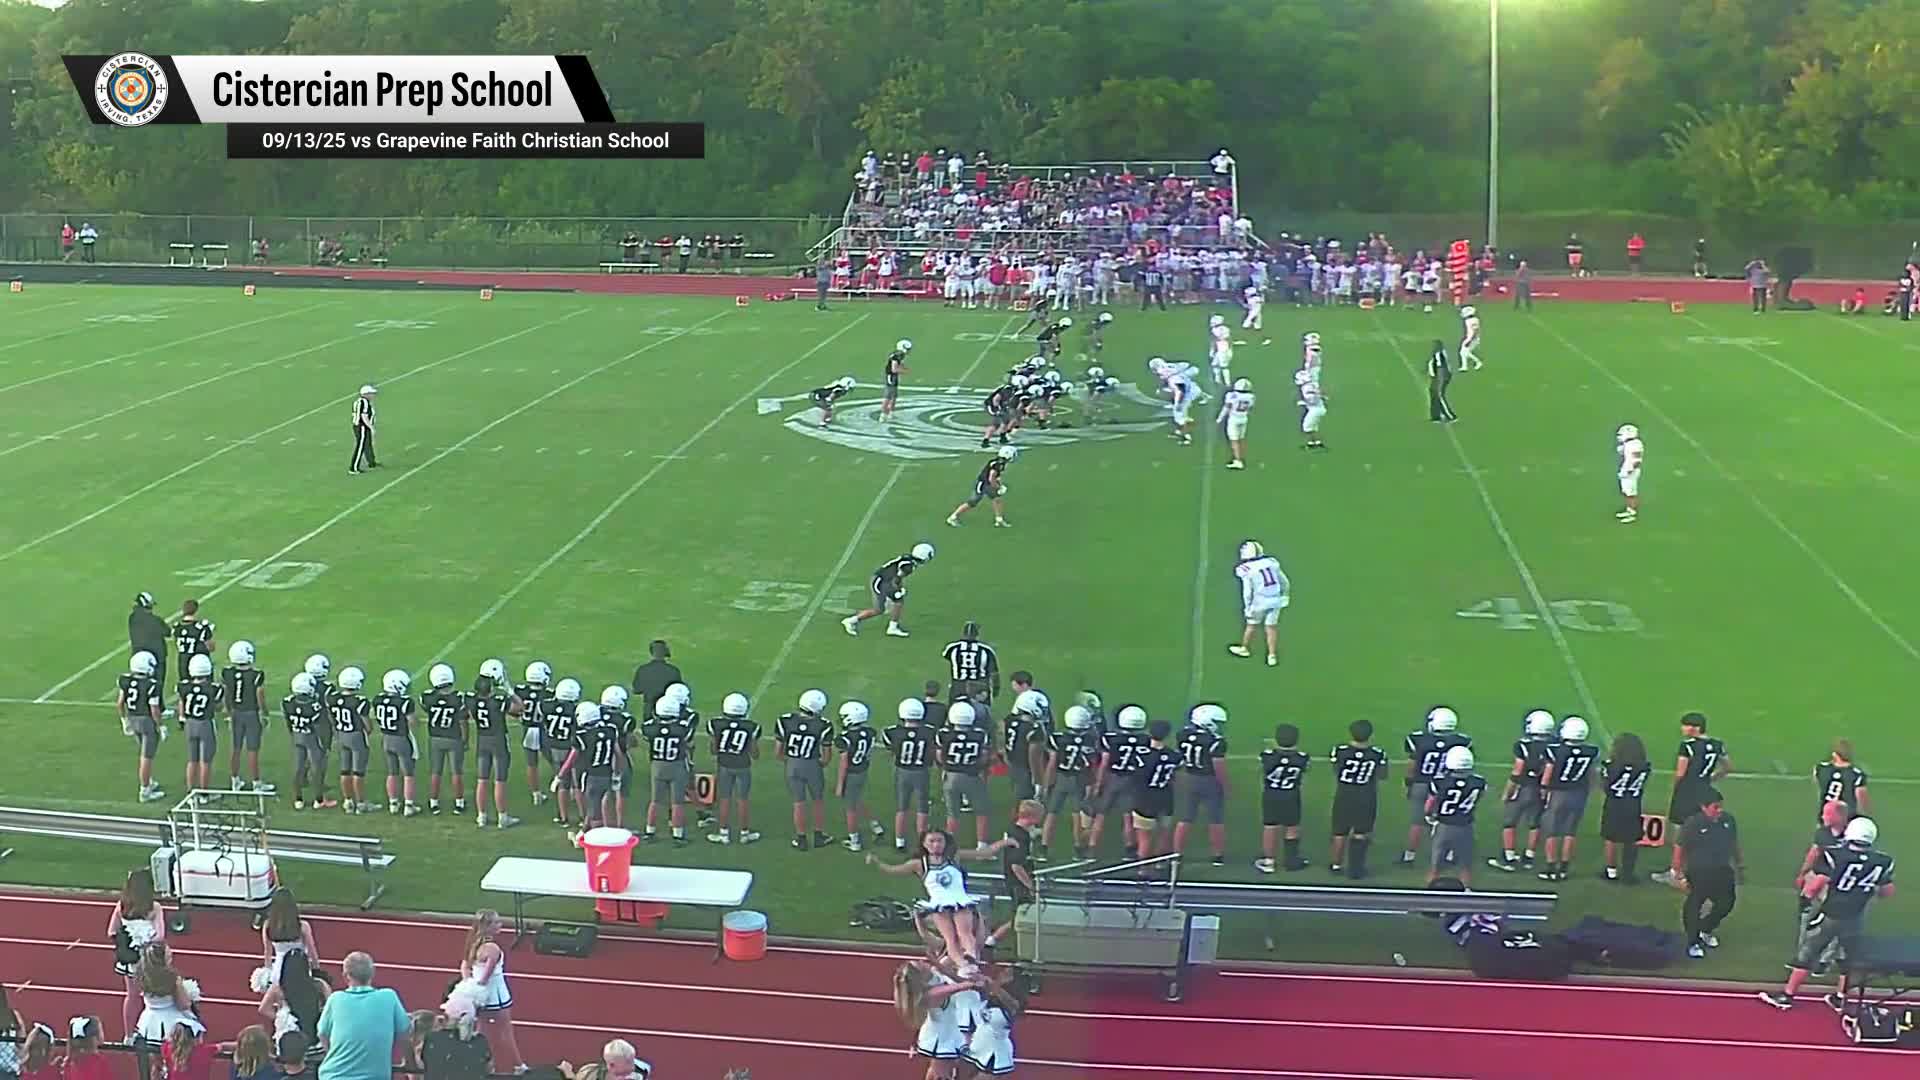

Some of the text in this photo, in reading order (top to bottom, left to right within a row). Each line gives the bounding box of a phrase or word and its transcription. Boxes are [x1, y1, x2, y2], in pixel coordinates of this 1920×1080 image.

[171, 560, 329, 589] 40
[1259, 566, 1277, 587] 11
[1455, 597, 1642, 632] 40
[960, 651, 977, 669] H
[127, 688, 138, 710] 2
[235, 680, 242, 703] 1
[184, 693, 208, 717] 12
[376, 707, 398, 730] 92
[430, 707, 455, 728] 76
[477, 709, 489, 728] 5
[547, 714, 572, 739] 75
[592, 738, 613, 767] 11
[653, 737, 680, 761] 96
[719, 729, 748, 754] 19
[788, 734, 816, 758] 50
[900, 740, 925, 766] 81
[947, 742, 979, 765] 52
[1340, 759, 1376, 784] 20
[1560, 757, 1590, 781] 17
[1699, 753, 1717, 778] 7
[1267, 766, 1300, 790] 42
[1610, 772, 1646, 797] 44
[1440, 788, 1480, 814] 24
[1837, 863, 1883, 892] 64
